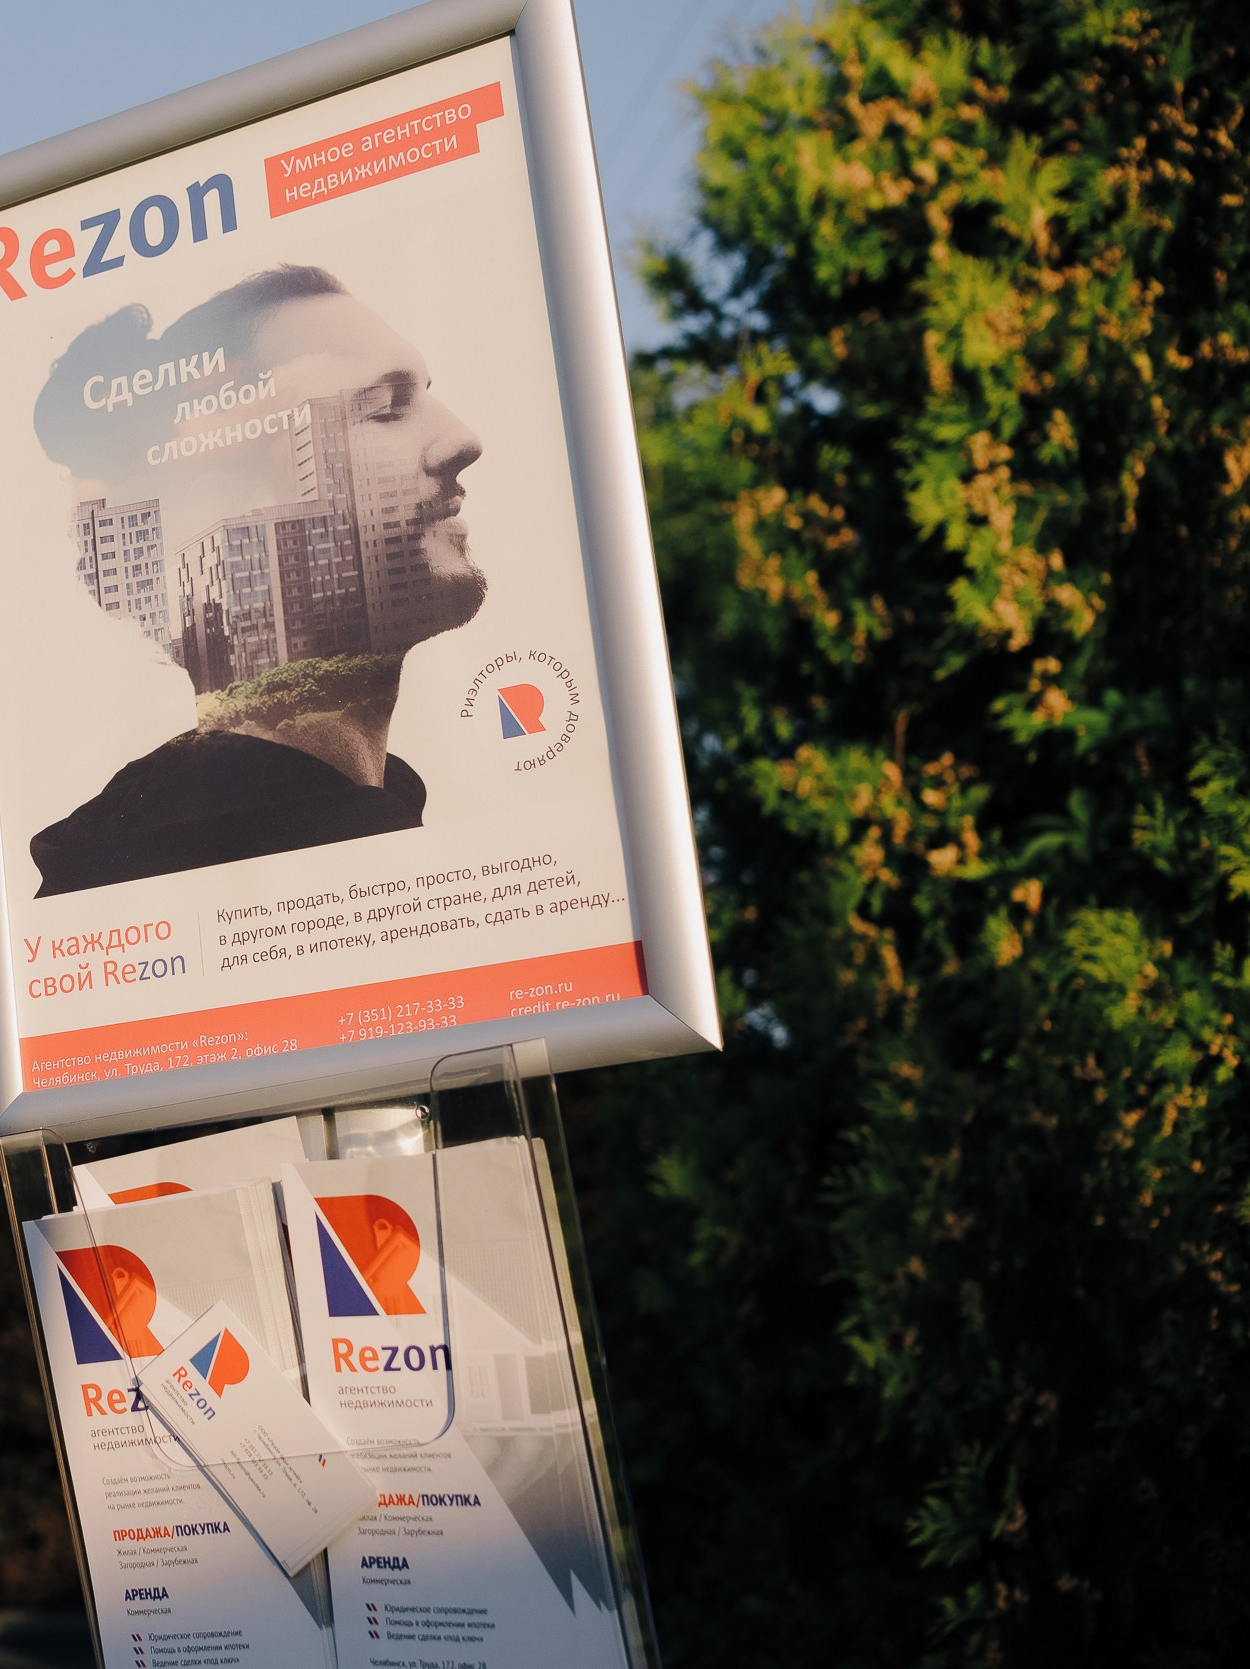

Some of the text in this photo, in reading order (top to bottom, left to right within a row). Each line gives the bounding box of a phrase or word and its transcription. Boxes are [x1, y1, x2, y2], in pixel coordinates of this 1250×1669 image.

[280, 103, 472, 177] Умное агентство
[285, 134, 458, 203] недвижимости
[83, 347, 226, 412] Сделки
[173, 370, 276, 424] любой
[146, 403, 312, 466] сложности
[460, 649, 580, 771] Риэлторы, которым доверяют
[216, 854, 558, 924] Купить, продать, быстро, просто, выгодно,
[219, 870, 581, 946] в другом городе, в другой стране, для детей,
[23, 920, 172, 963] У каждого
[220, 954, 248, 971] для
[252, 945, 292, 963] себя,
[296, 944, 305, 956] в
[309, 934, 376, 954] ипотеку,
[380, 915, 480, 942] арендовать,
[484, 908, 531, 926] сдать
[535, 904, 544, 916] в
[28, 955, 186, 999] свой Rezon
[509, 981, 573, 1000] re-zon.ru
[338, 995, 465, 1026] +7 (351) 217-33-33
[339, 1015, 457, 1043] +7 919-123-93-33
[31, 1031, 249, 1072] Агентство недвижимости «Rezon»:
[32, 1072, 101, 1088] Челябинск,
[104, 1068, 122, 1080] ул.
[124, 1061, 163, 1076] Труда,
[196, 1052, 227, 1065] этаж
[245, 1043, 279, 1058] офис
[282, 1038, 298, 1053] 28
[331, 1337, 452, 1373] Rezon
[172, 1365, 216, 1421] Rezon
[338, 1385, 396, 1395] агентство
[80, 1383, 149, 1417] Rez
[339, 1398, 434, 1410] недвижимости
[90, 1424, 145, 1438] агентство
[92, 1434, 181, 1452] недвижимости
[130, 1473, 171, 1484] возможность
[104, 1488, 141, 1499] реализации
[171, 1482, 201, 1492] клиентов
[117, 1502, 136, 1512] рынке
[378, 1493, 481, 1508] ДАЖА/ПОКУПКА
[383, 1513, 433, 1523] Коммерческая
[112, 1521, 231, 1542] ПРОДАЖА/ПОКУПКА
[357, 1526, 396, 1537] Загородная
[402, 1526, 444, 1537] Зарубежная
[116, 1548, 137, 1557] Жилая
[142, 1545, 188, 1556] Коммерческая
[119, 1560, 155, 1570] Загородная
[161, 1557, 198, 1568] Зарубежная
[361, 1556, 410, 1571] АРЕНДА
[362, 1576, 411, 1586] Коммерческая
[124, 1586, 169, 1602] АРЕНДА
[126, 1606, 171, 1617] Коммерческая
[384, 1603, 488, 1615] Юридическое сопровождение
[385, 1617, 413, 1627] Помощь
[421, 1618, 465, 1628] оформлении
[148, 1629, 243, 1643] Юридическое сопровождение
[150, 1645, 176, 1655] Помощь
[182, 1643, 223, 1654] оформлении
[224, 1642, 250, 1651] ипотеки
[152, 1658, 179, 1668] Ведение
[180, 1657, 202, 1667] сделки
